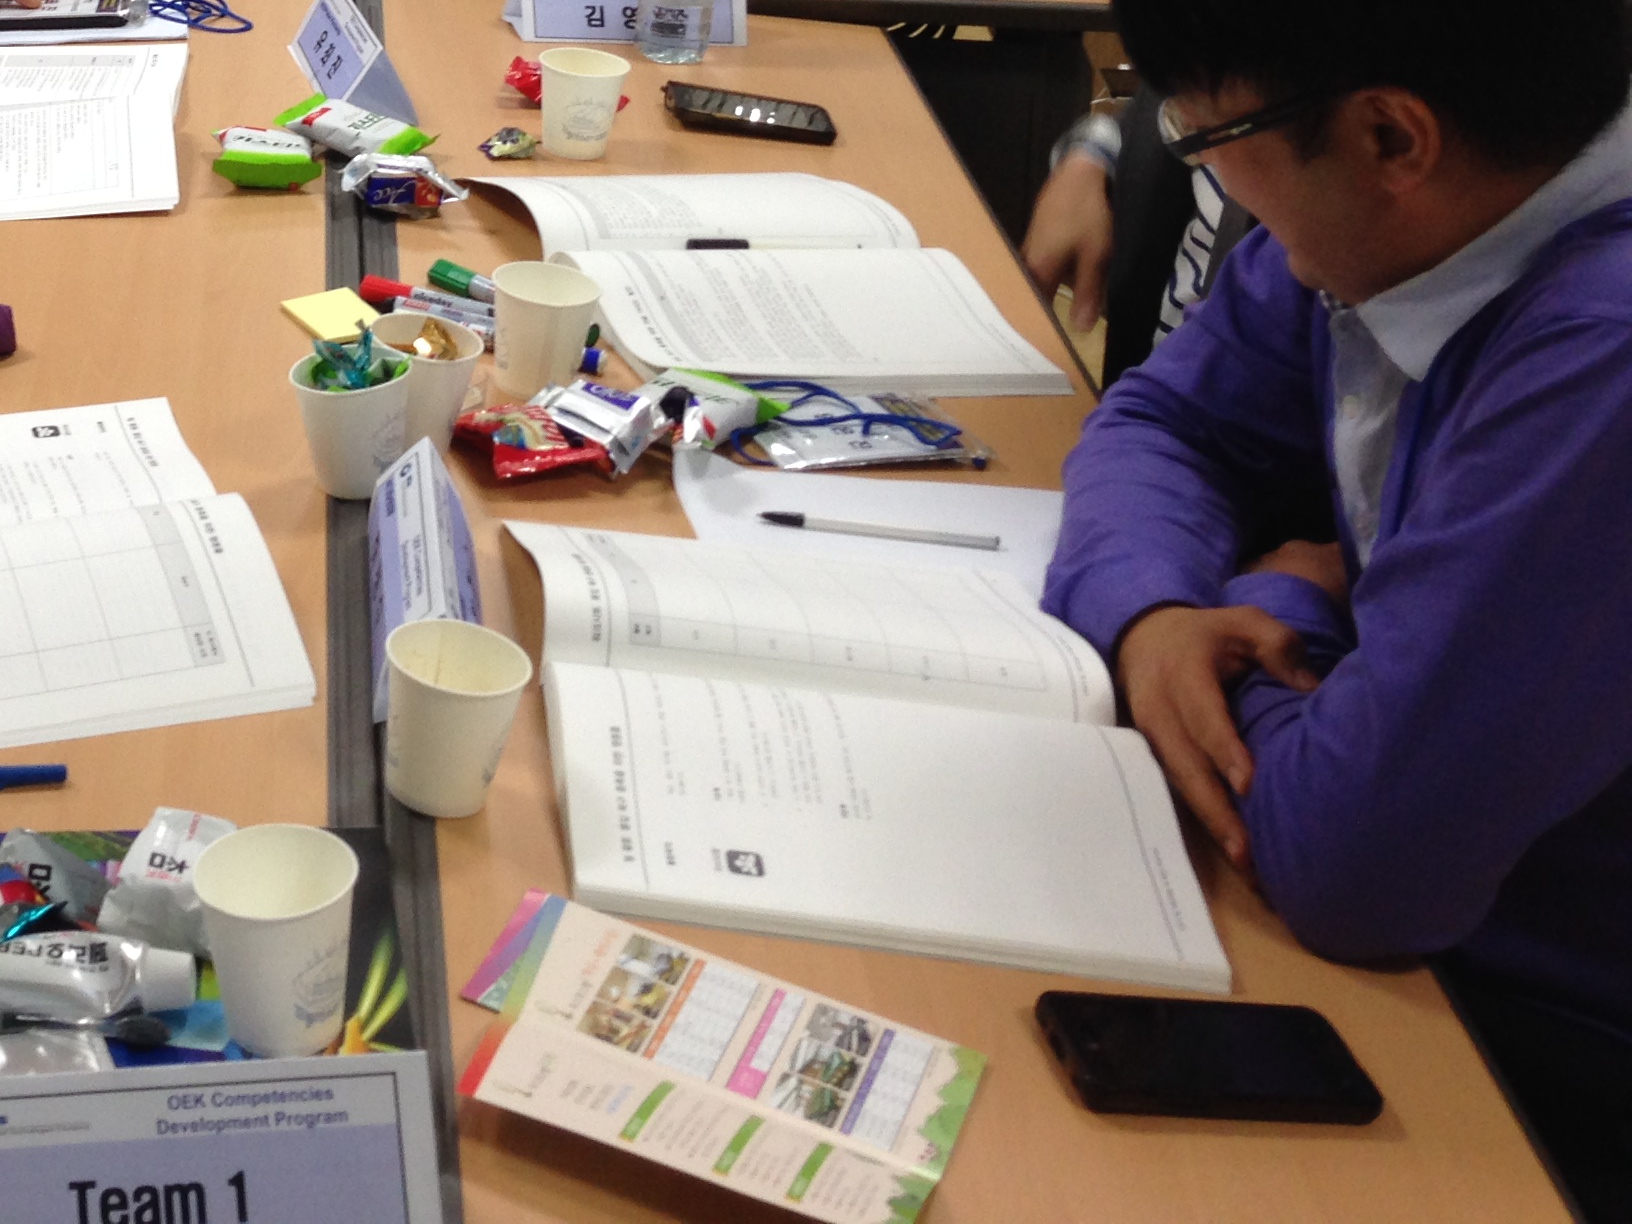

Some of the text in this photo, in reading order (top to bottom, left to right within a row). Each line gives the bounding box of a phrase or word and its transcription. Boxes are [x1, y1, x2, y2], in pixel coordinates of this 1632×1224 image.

[167, 1085, 334, 1111] OEK Competencies
[156, 1108, 349, 1136] Development Program
[68, 1170, 249, 1224] Team 1
